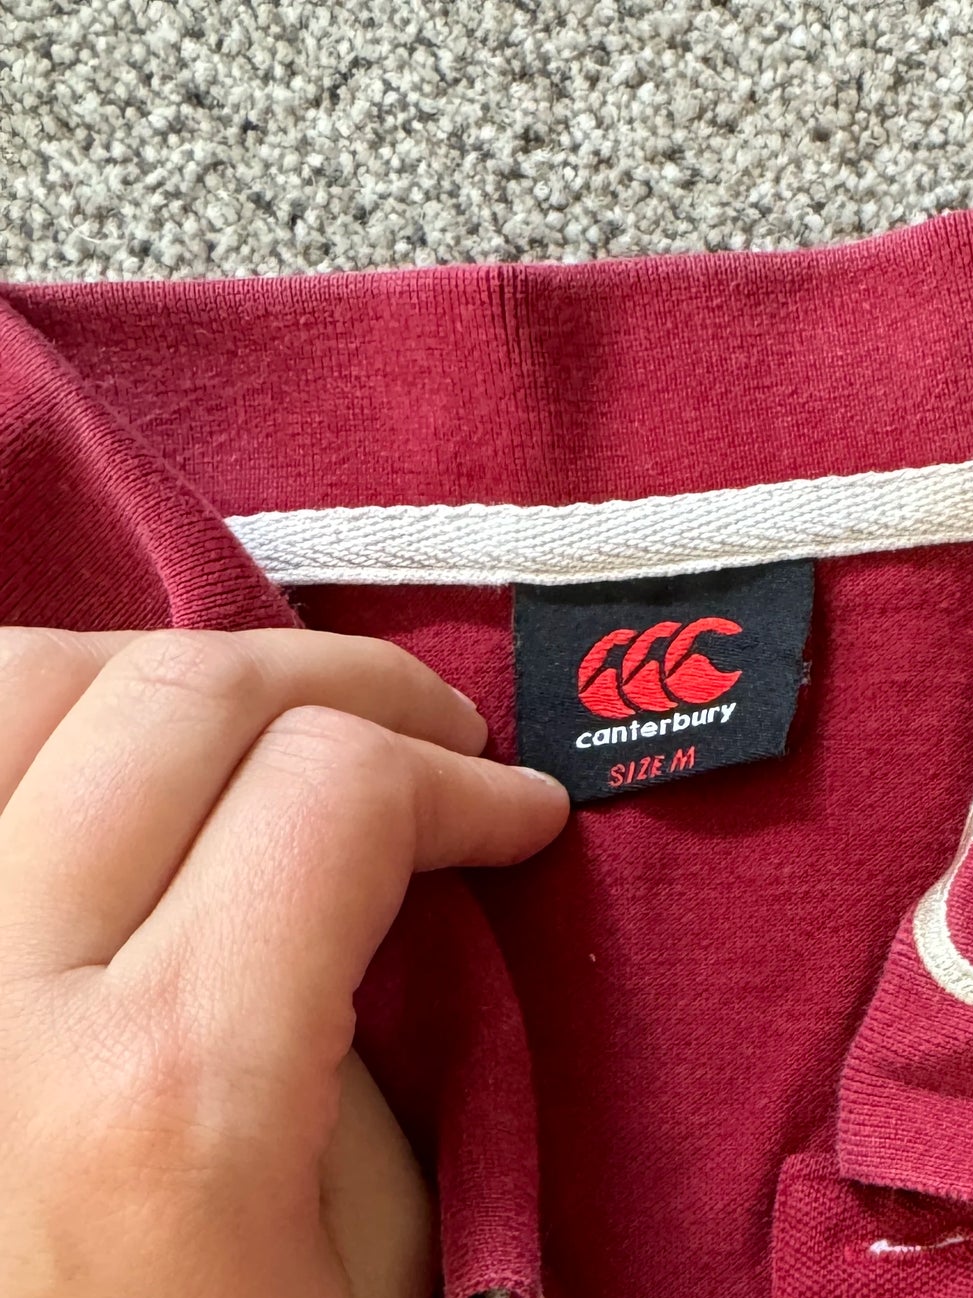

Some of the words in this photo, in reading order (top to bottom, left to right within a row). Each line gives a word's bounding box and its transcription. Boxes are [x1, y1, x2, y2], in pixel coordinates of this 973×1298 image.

[576, 702, 737, 749] canterbury
[608, 755, 666, 788] SIZE
[669, 745, 696, 773] M
